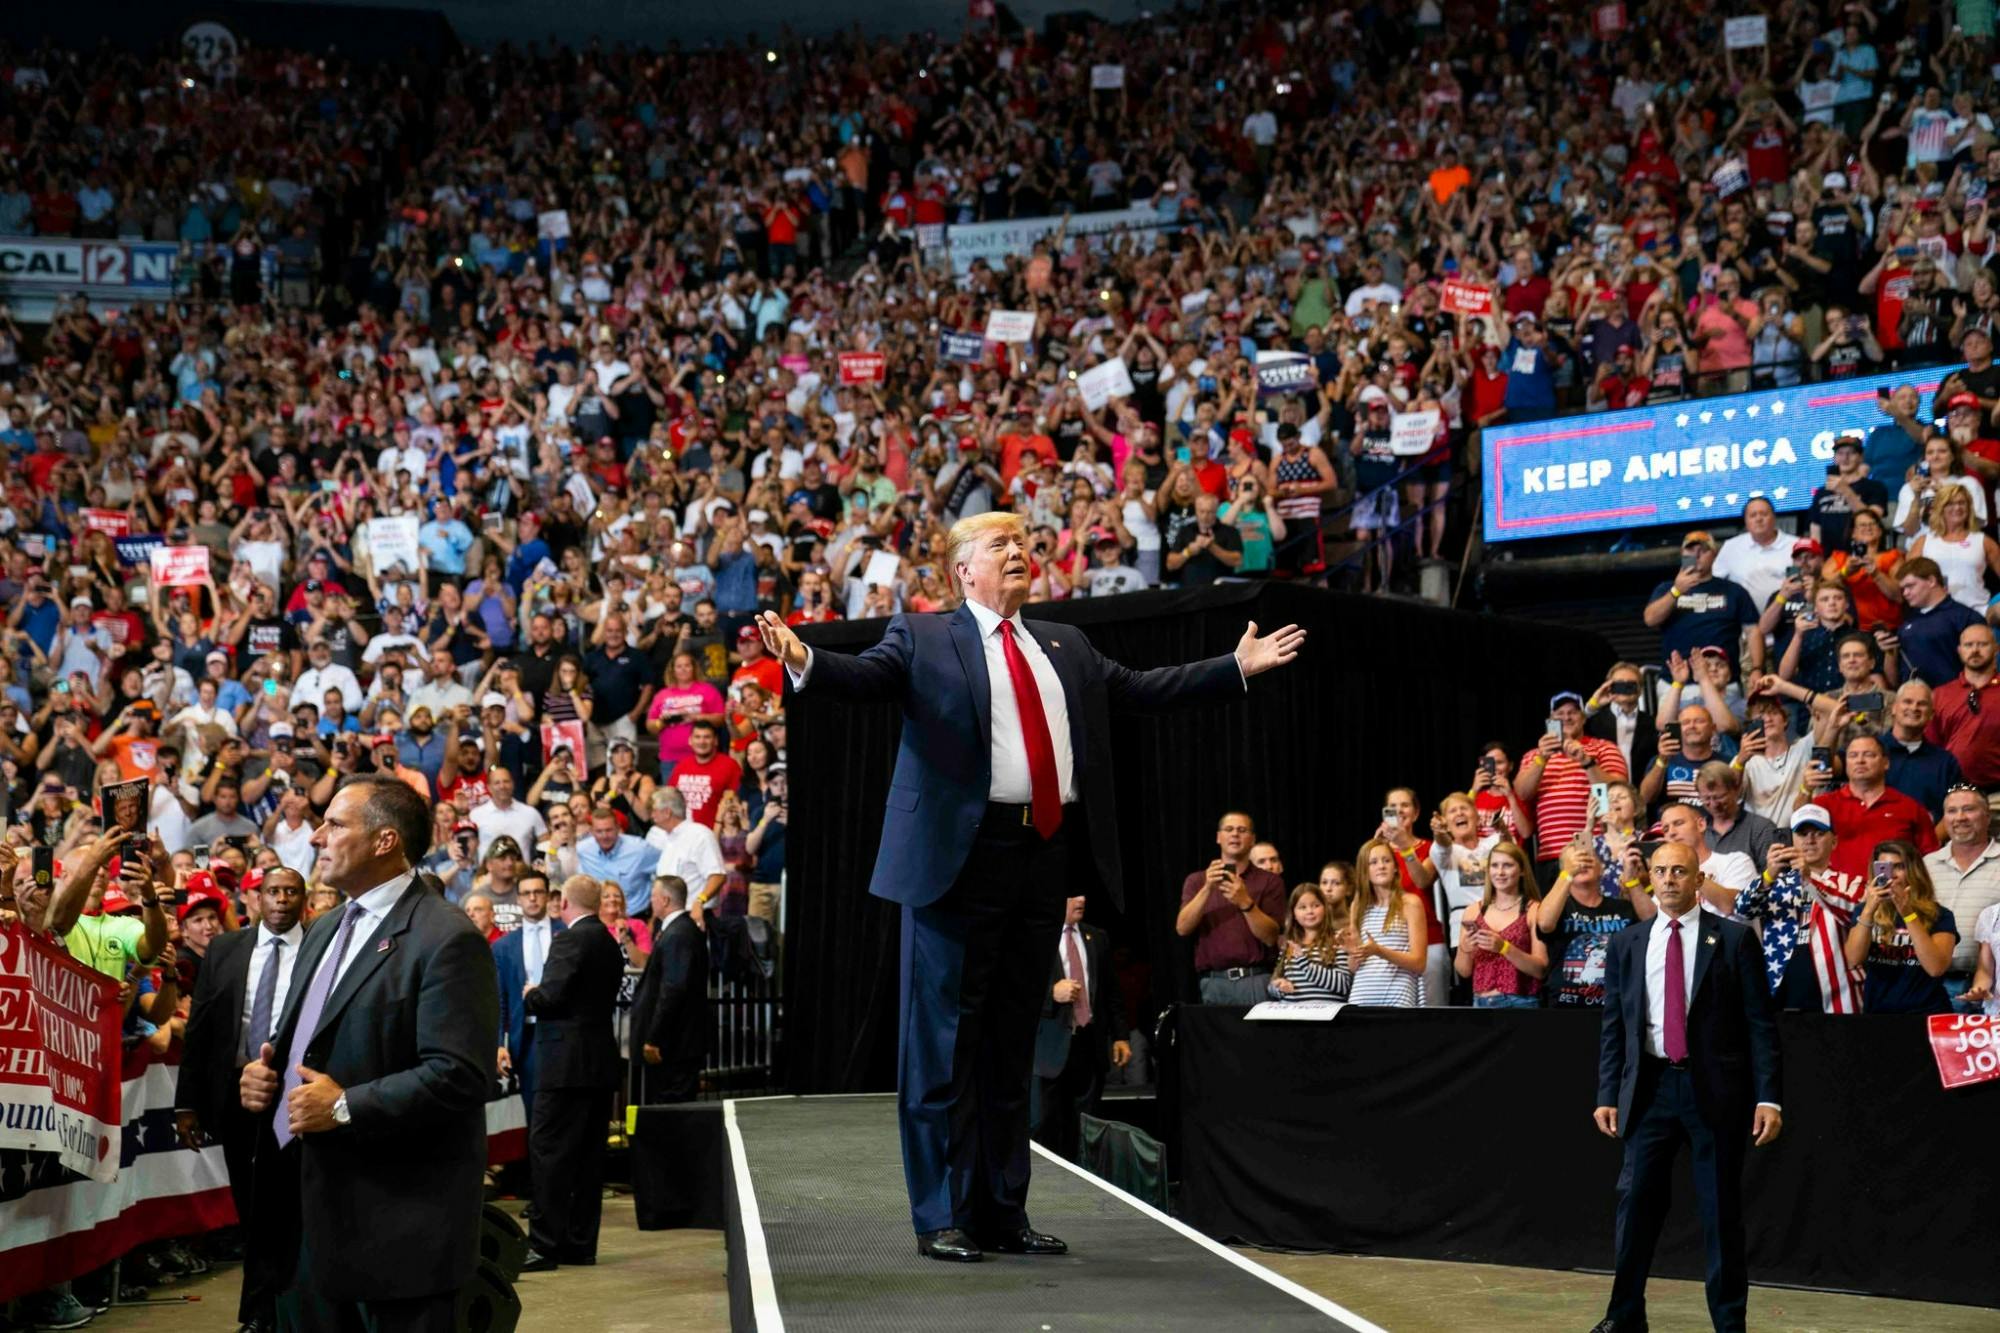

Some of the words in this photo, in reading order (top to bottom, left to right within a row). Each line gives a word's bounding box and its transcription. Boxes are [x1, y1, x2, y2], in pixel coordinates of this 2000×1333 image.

[86, 247, 127, 284] 12
[1523, 458, 1612, 494] KEEP
[1623, 437, 1797, 483] AMERICA
[40, 1007, 102, 1072] TRUMP!
